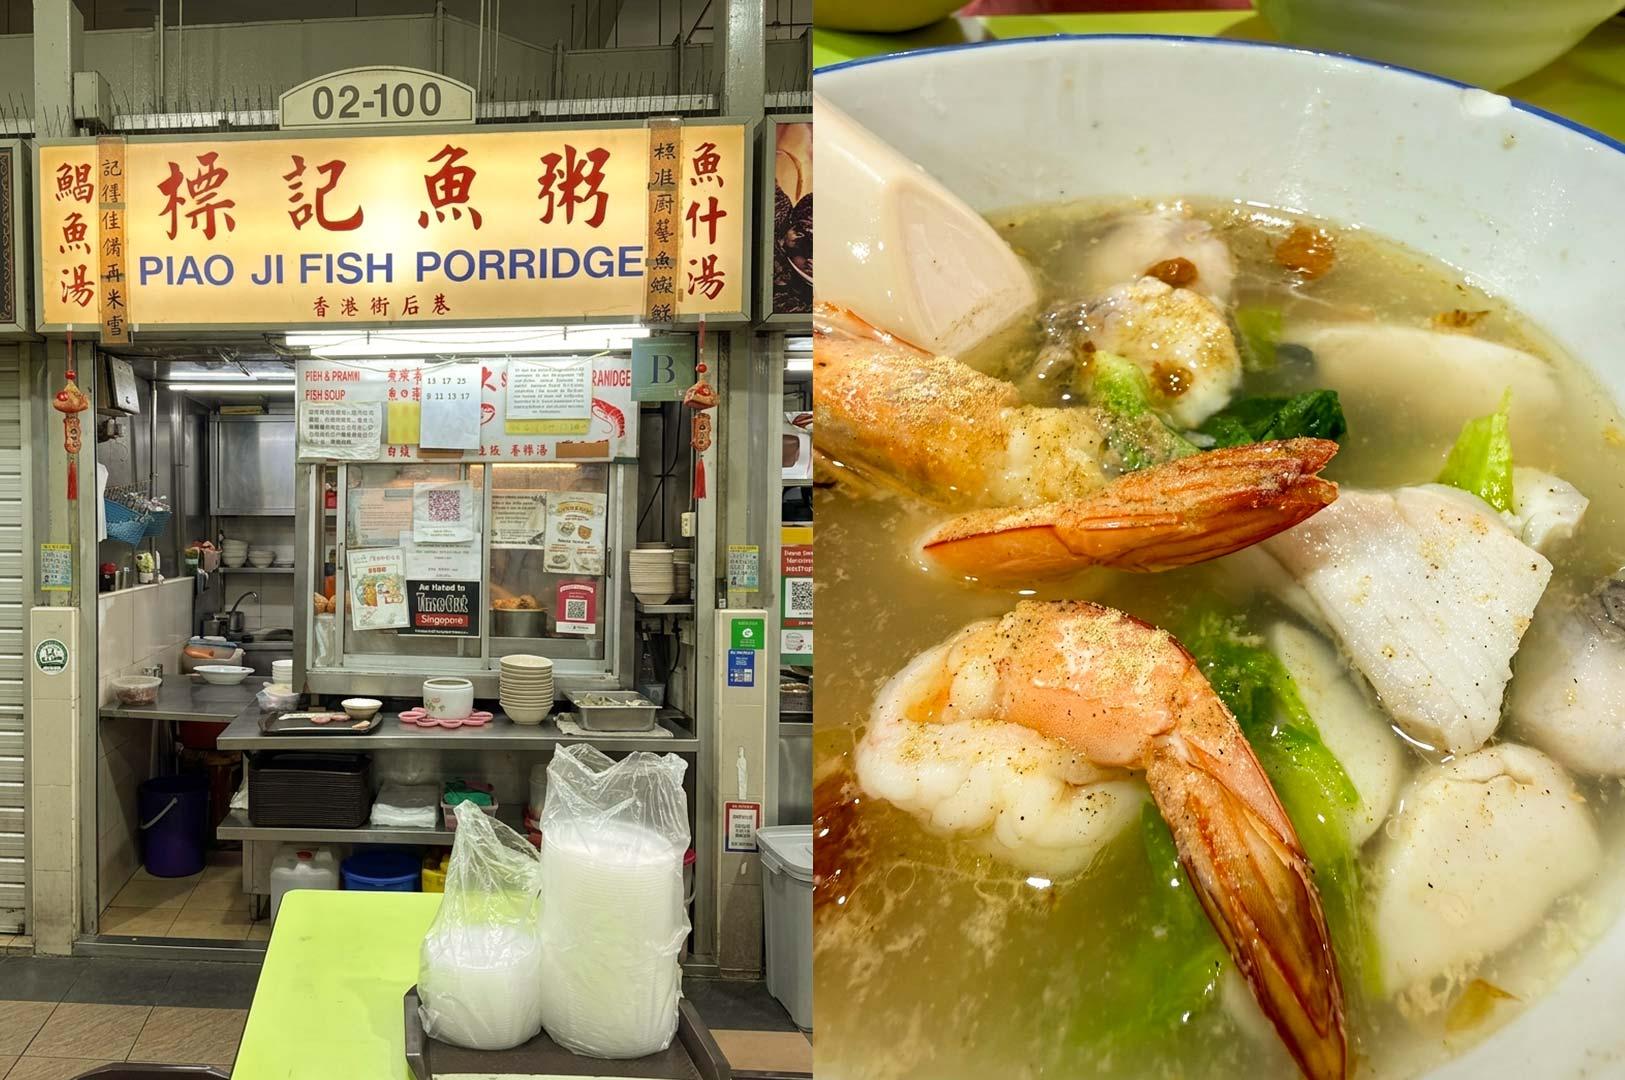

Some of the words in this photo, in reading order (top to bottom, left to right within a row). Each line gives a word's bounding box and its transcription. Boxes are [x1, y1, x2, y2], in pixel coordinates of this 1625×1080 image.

[312, 82, 442, 120] 02-100
[157, 144, 611, 241] 標記魚粥
[686, 141, 728, 301] 魚什湯
[139, 254, 235, 286] PIAO
[251, 254, 283, 285] JI
[300, 252, 393, 284] FISH
[416, 245, 645, 282] PORRIDGE
[651, 354, 676, 384] B
[305, 389, 323, 401] FISH
[324, 389, 346, 401] SOUP
